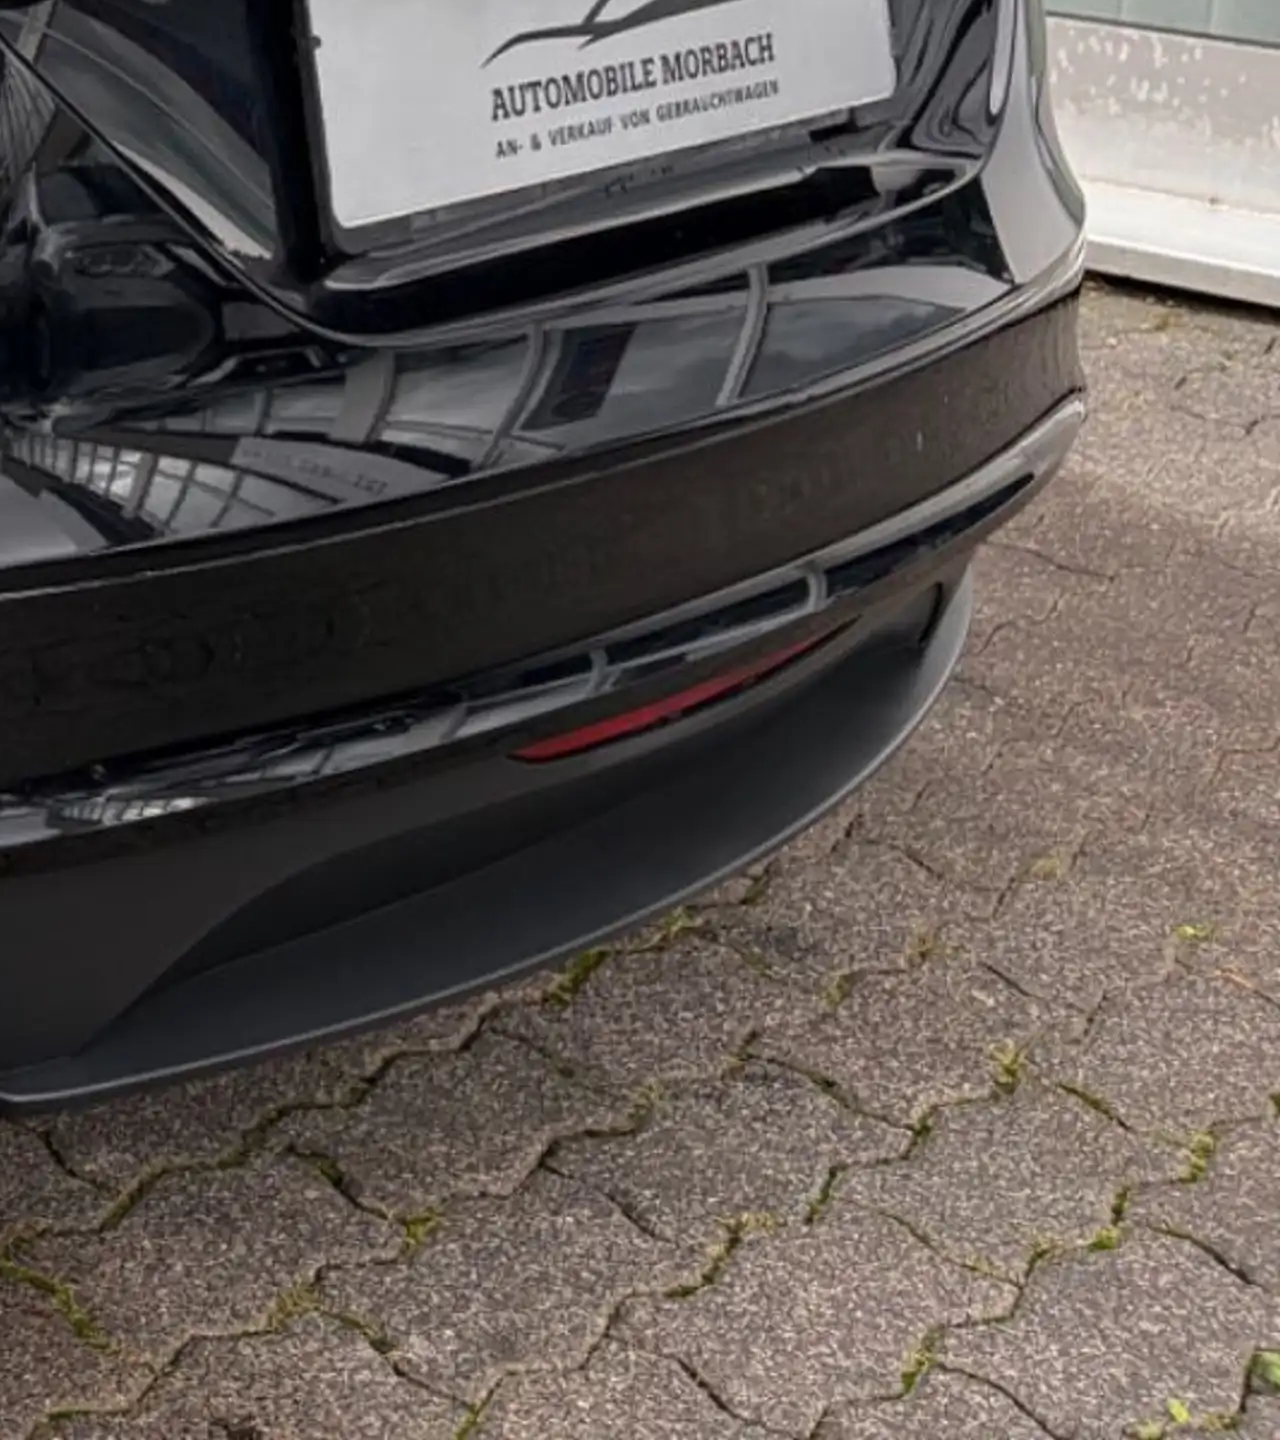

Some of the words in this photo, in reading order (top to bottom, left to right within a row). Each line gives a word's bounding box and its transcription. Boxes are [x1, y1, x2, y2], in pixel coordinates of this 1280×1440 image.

[491, 56, 657, 121] AUTOMOBILE
[661, 32, 776, 87] MORBACH
[495, 139, 524, 160] AN-
[530, 132, 542, 152] &
[548, 115, 613, 147] VERKAUF
[620, 109, 651, 130] VON
[656, 78, 780, 122] GEBRAUCHTWAGEN
